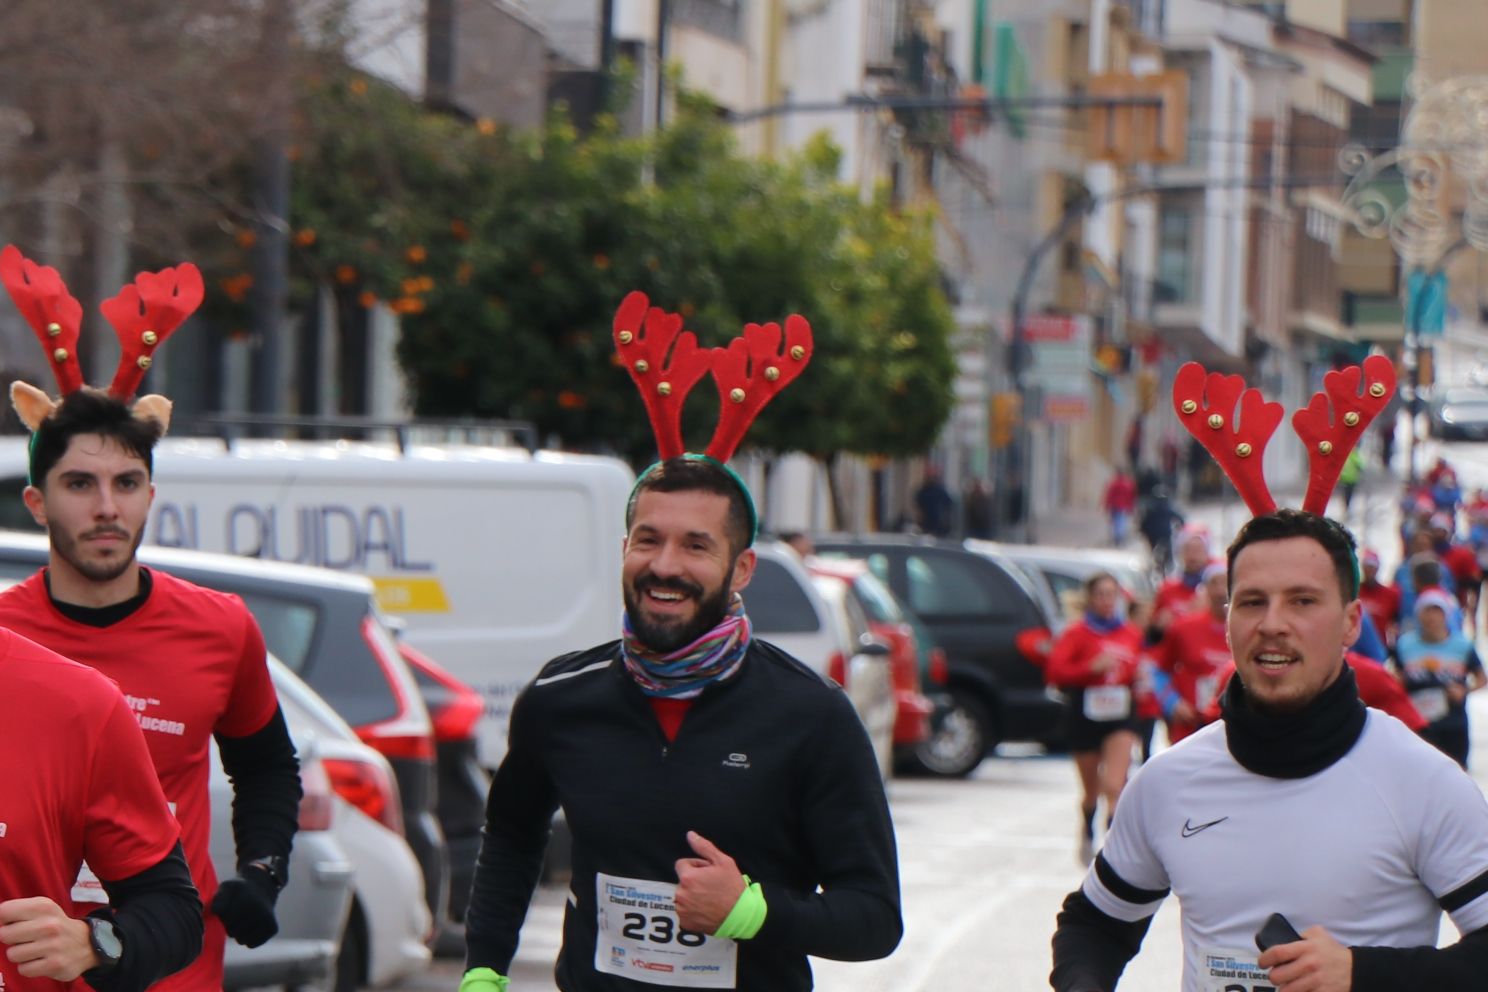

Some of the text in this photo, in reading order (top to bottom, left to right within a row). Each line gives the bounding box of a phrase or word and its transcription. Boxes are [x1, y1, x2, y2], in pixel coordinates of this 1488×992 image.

[610, 896, 636, 907] Ciudad
[650, 901, 677, 911] Lucen
[1210, 969, 1269, 980] Ciudad de Luce
